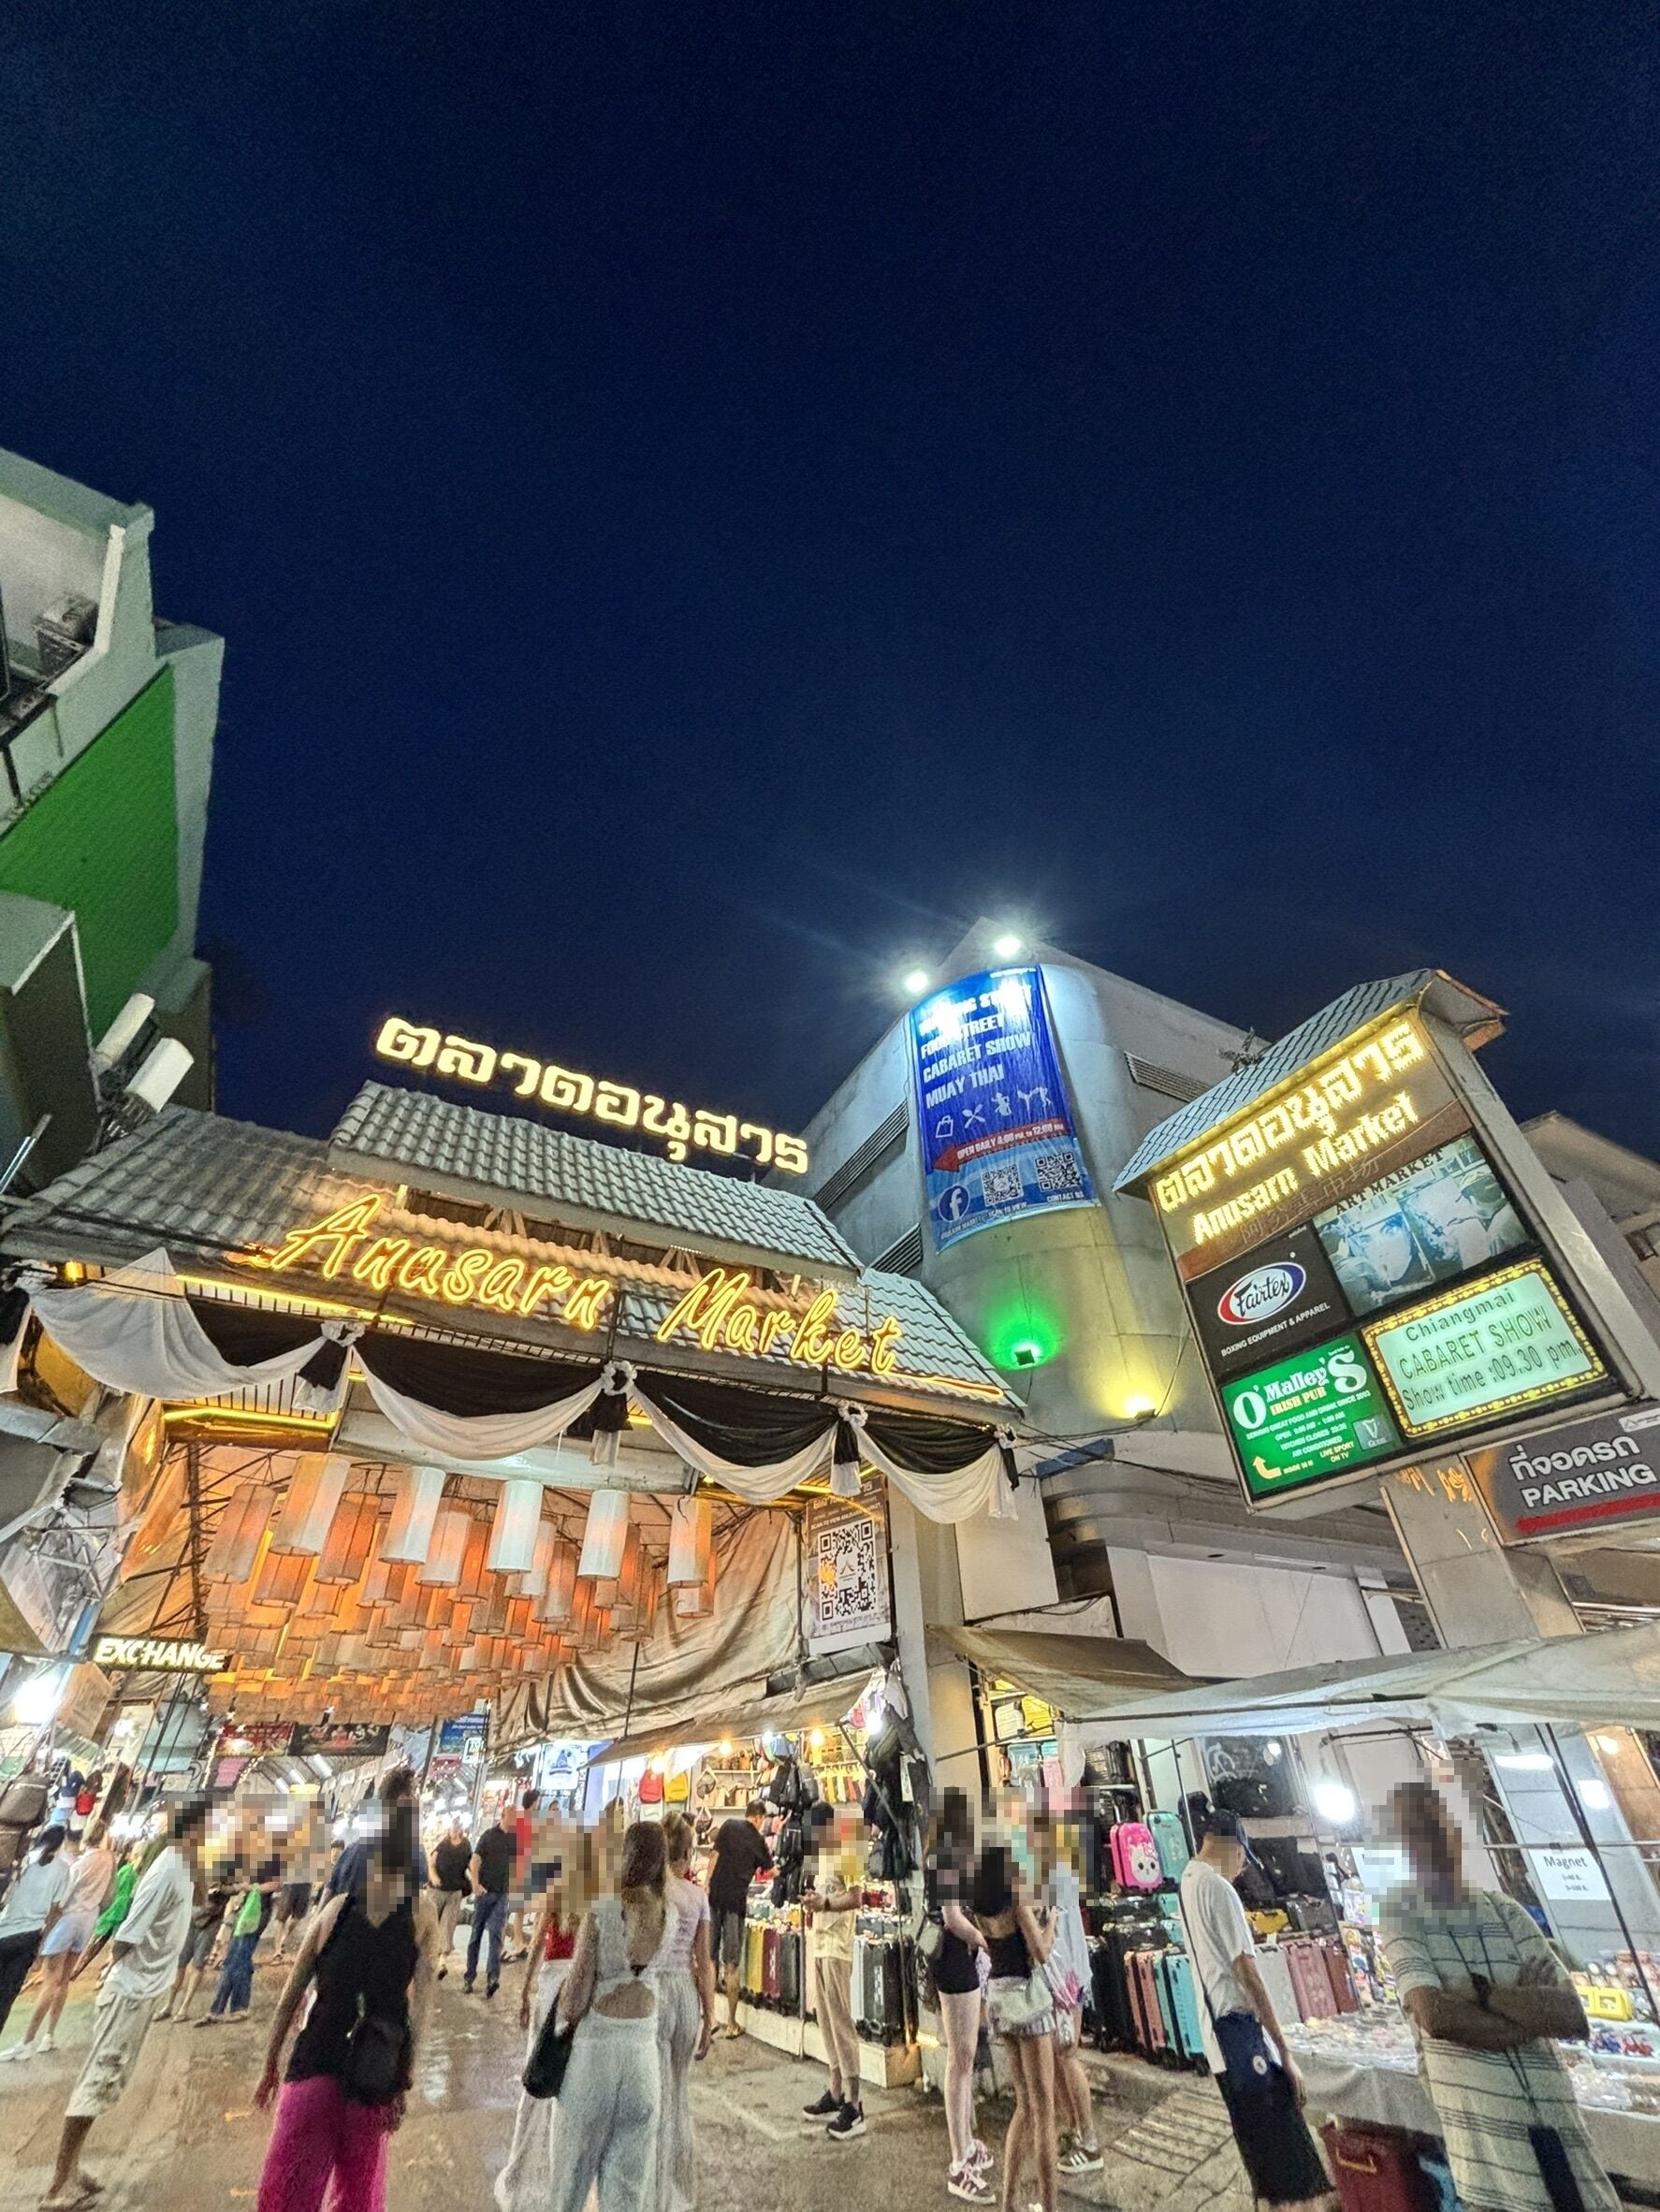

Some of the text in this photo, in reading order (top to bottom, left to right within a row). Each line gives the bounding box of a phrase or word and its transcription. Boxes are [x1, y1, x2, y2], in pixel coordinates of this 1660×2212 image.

[924, 1031, 1031, 1083] CABARET SHOW
[376, 1016, 808, 1174] ตลาดอนุสาร
[925, 1064, 1005, 1109] MUAY THAI
[1156, 1021, 1424, 1213] ตลาดอนุสาร
[957, 1147, 975, 1159] OPEN
[975, 1137, 997, 1152] DAILY
[1192, 1090, 1419, 1245] Anusarn Market
[1334, 1149, 1445, 1215] ART MARKET
[271, 1192, 904, 1375] Anusarn Market
[1233, 1272, 1290, 1317] Fairtex
[1221, 1302, 1331, 1357] BOXING EQUIPMENT & APPAREL
[1405, 1288, 1515, 1342] Chiangmai
[1399, 1305, 1553, 1380] CABARET SHOW
[1270, 1386, 1327, 1416] IRISH PUB
[1402, 1382, 1446, 1411] Show
[1448, 1370, 1486, 1397] time
[1319, 1441, 1354, 1458] LIVE SPORT
[1331, 1451, 1349, 1463] ON TV
[1508, 1435, 1641, 1481] ที่จอดรถ
[1521, 1463, 1657, 1508] PARKING
[94, 1637, 226, 1670] EXCHANGE
[1543, 1855, 1588, 1870] Magnet
